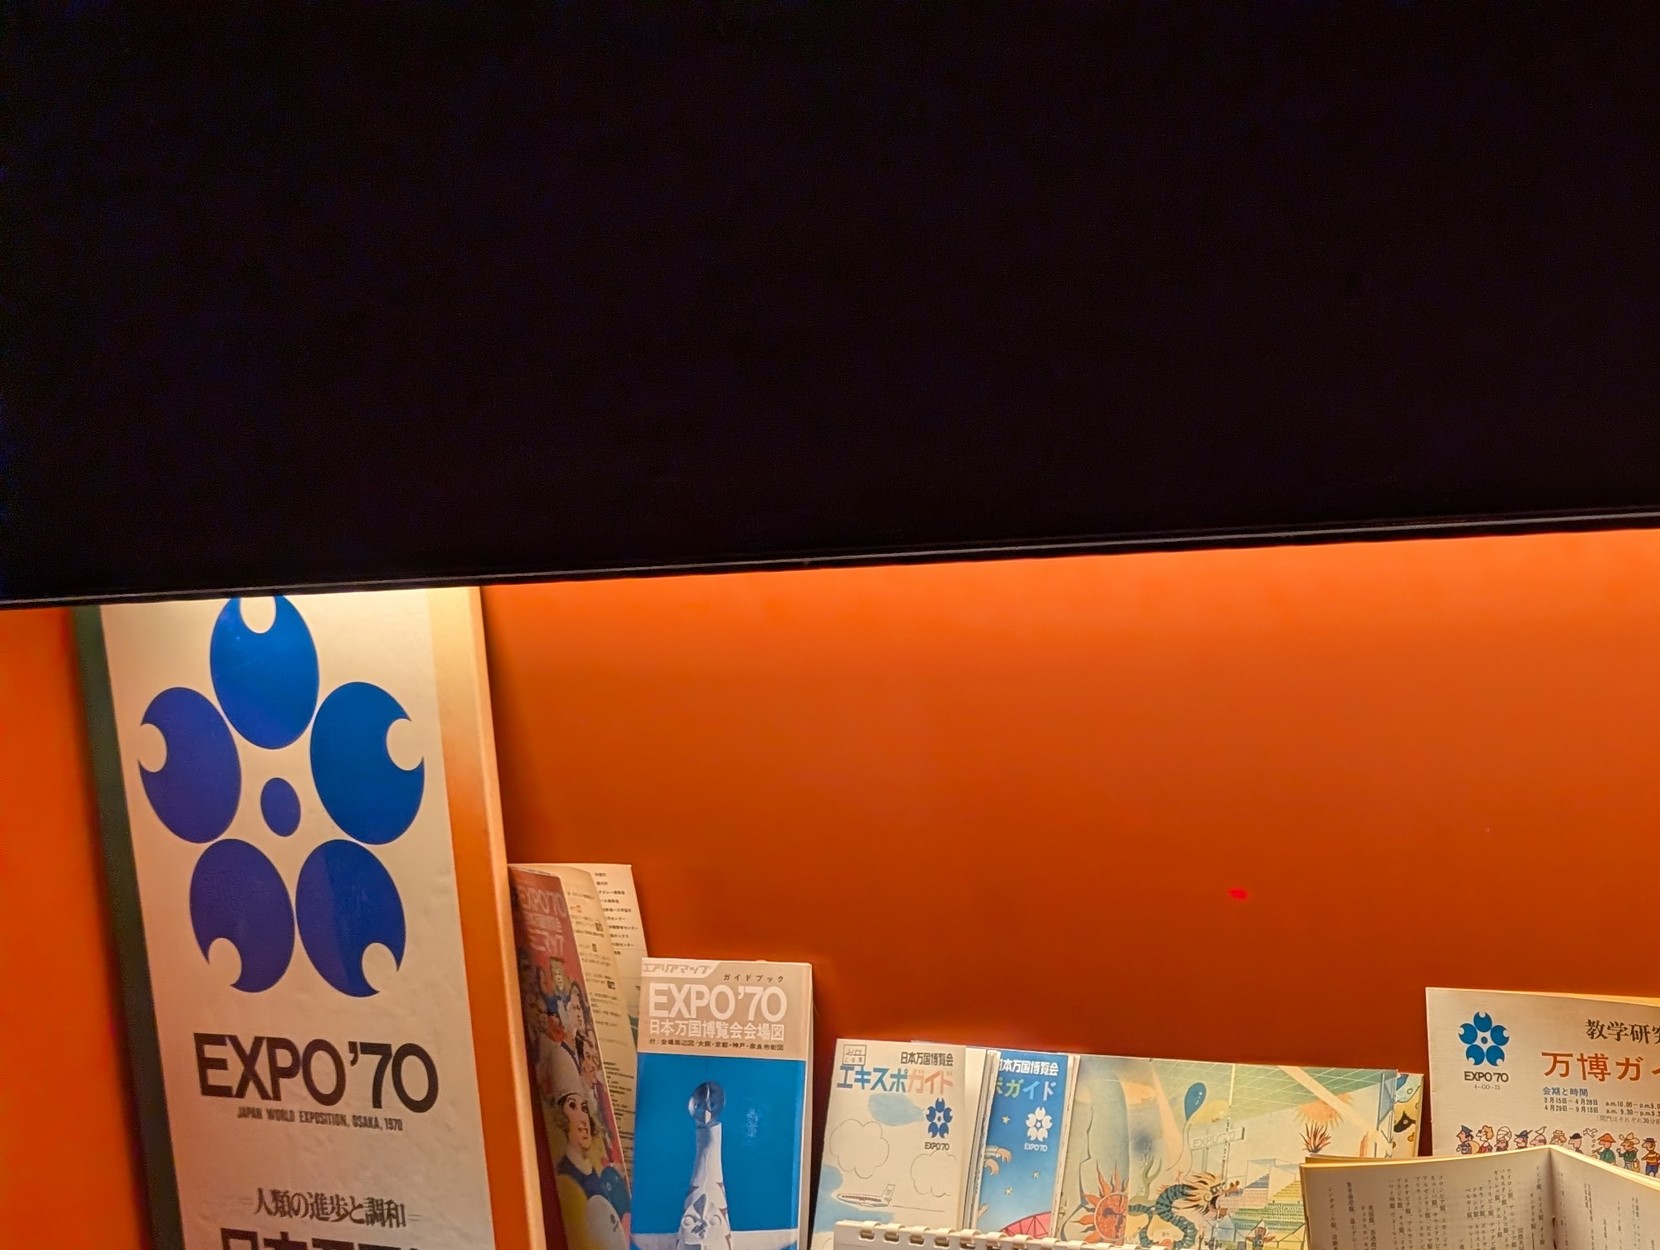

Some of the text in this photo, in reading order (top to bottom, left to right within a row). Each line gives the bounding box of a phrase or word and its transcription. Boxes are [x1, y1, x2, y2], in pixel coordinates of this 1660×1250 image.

[723, 974, 784, 983] ガイドブック
[649, 1019, 785, 1041] 日本万国博覧会会場図
[900, 1051, 954, 1067] 日本万国博覧会
[837, 1064, 953, 1096] エキスポガイド
[254, 1187, 408, 1229] 人類の進歩と調和
